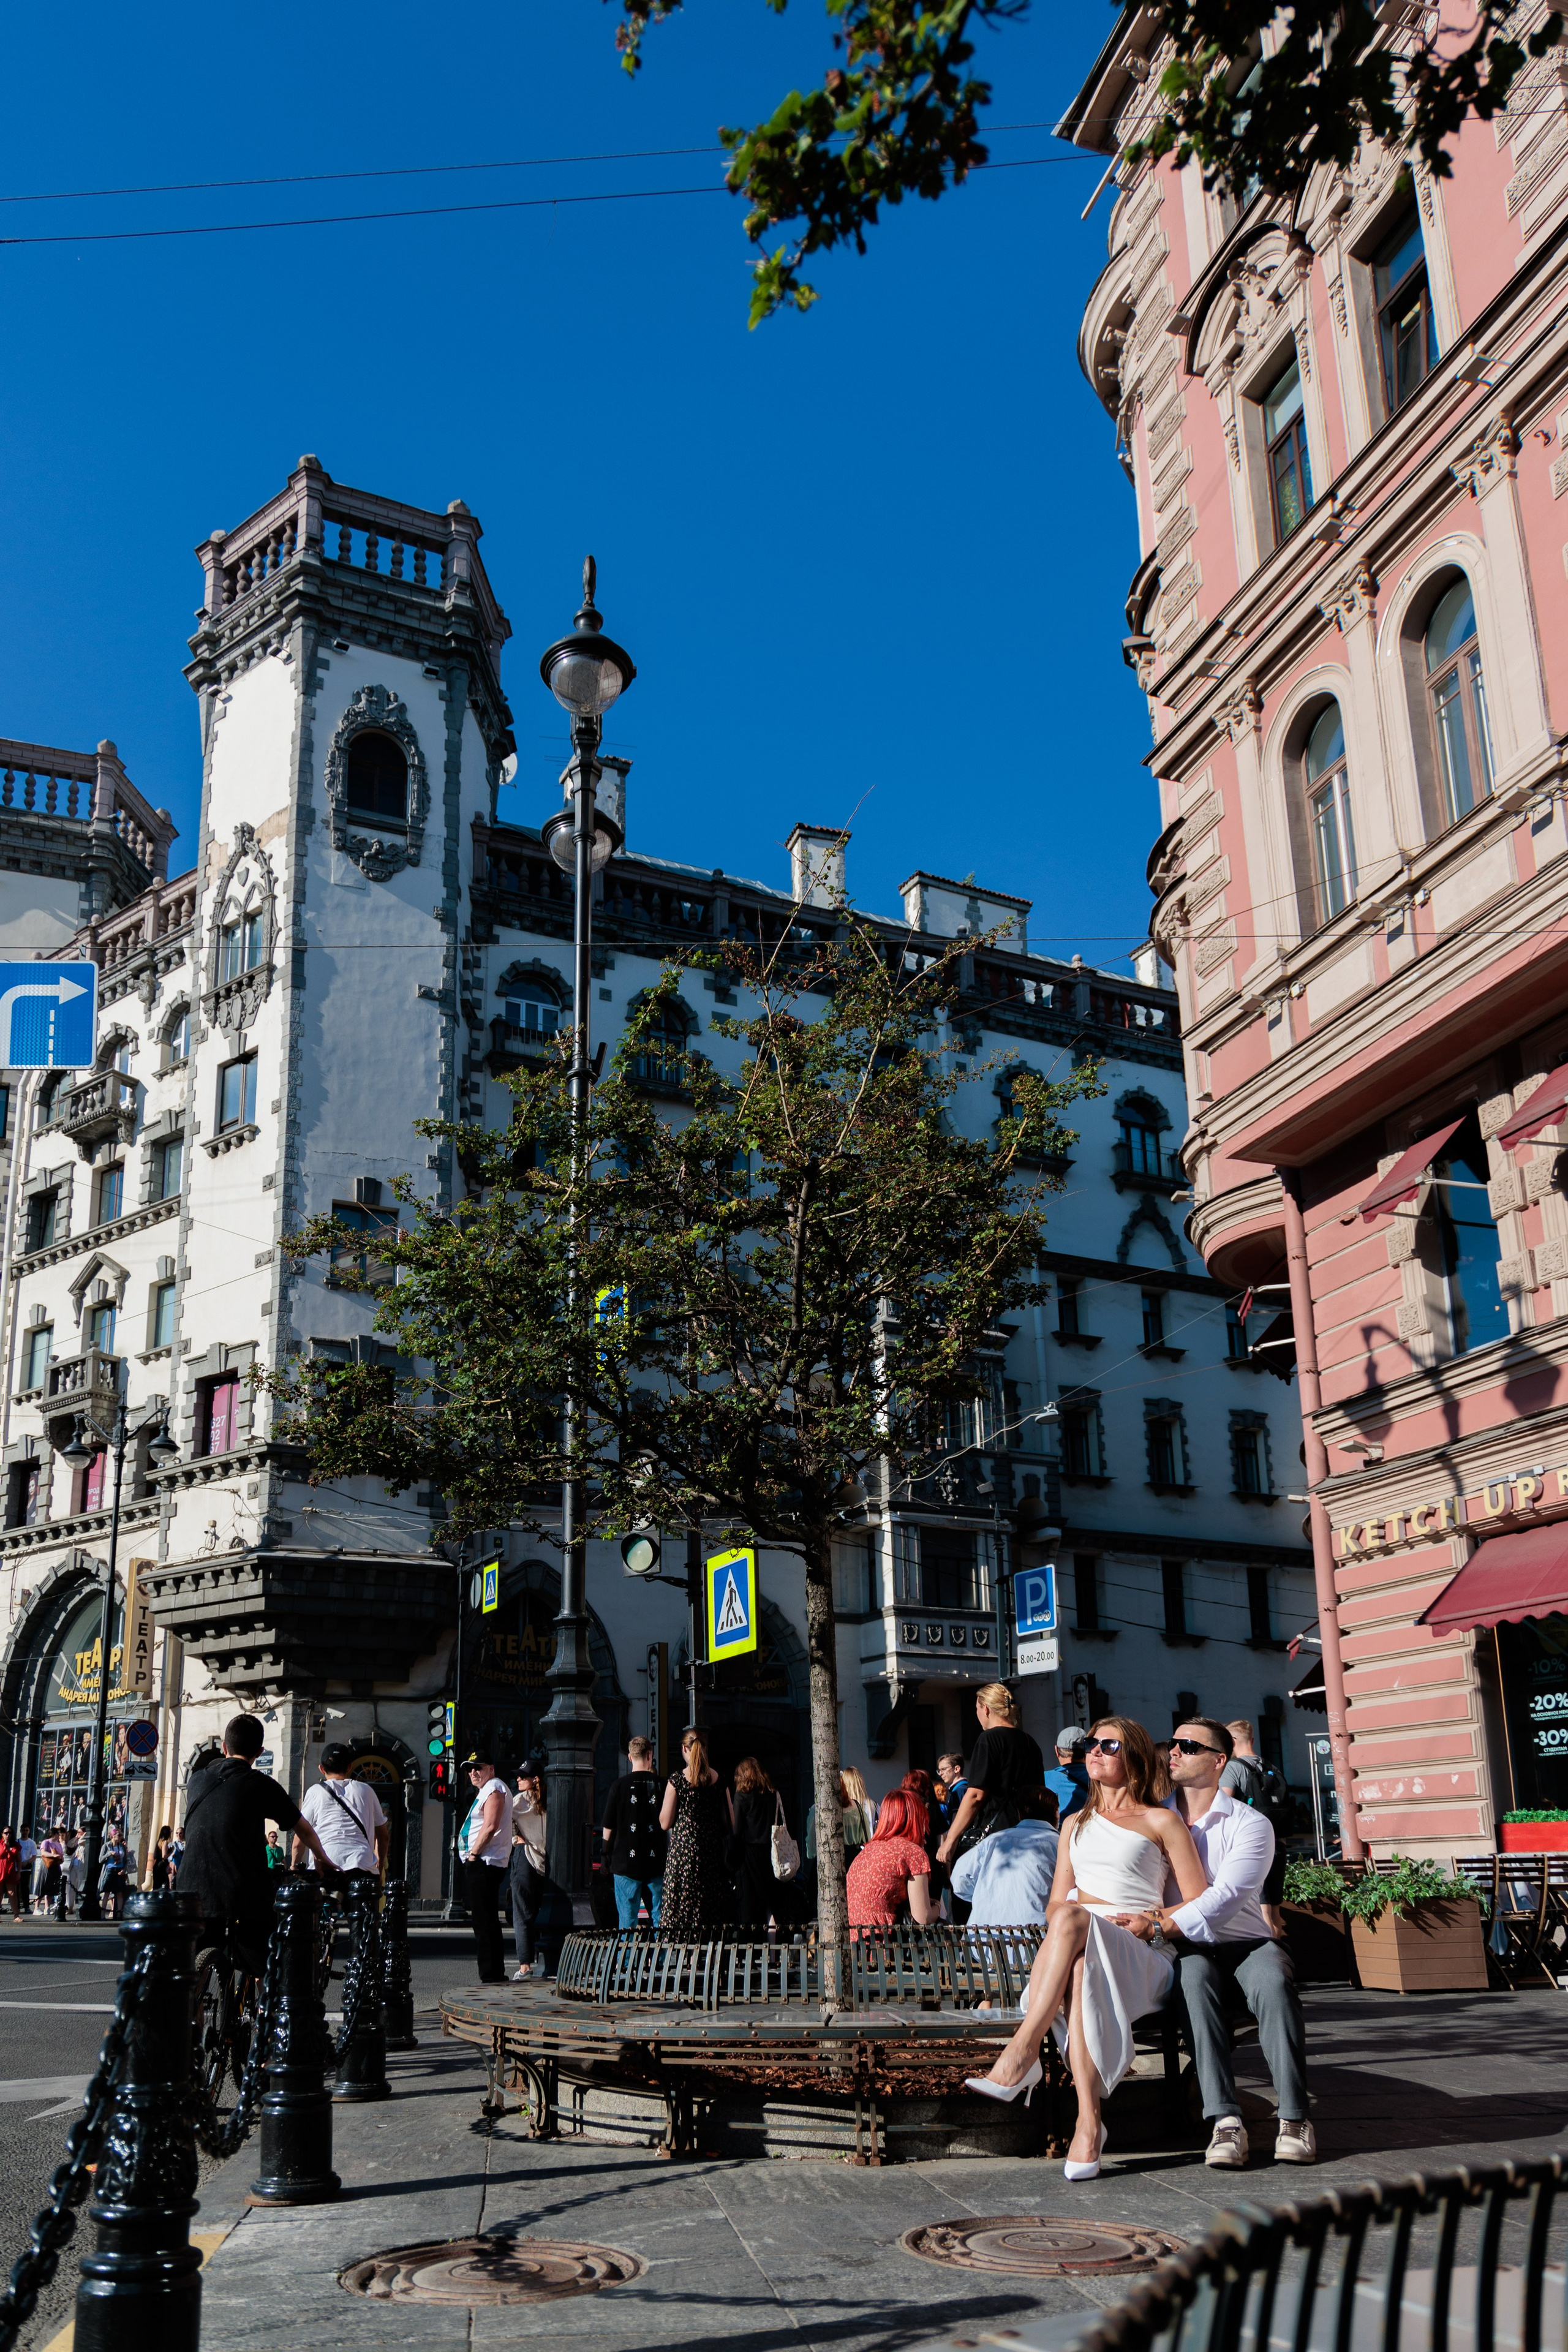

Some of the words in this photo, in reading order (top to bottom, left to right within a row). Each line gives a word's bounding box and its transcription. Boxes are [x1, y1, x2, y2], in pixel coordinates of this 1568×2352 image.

[1340, 1496, 1466, 1555] KETCH
[1483, 1477, 1540, 1516] UP
[1025, 1577, 1046, 1626] P
[75, 1637, 121, 1675] ТЕАР
[135, 1605, 149, 1685] ТЕАТР
[1020, 1651, 1054, 1664] 8.00-20.00
[1527, 1657, 1566, 1675] -10%
[58, 1686, 88, 1703] АНДРЕЯ
[1529, 1692, 1568, 1711] -20%
